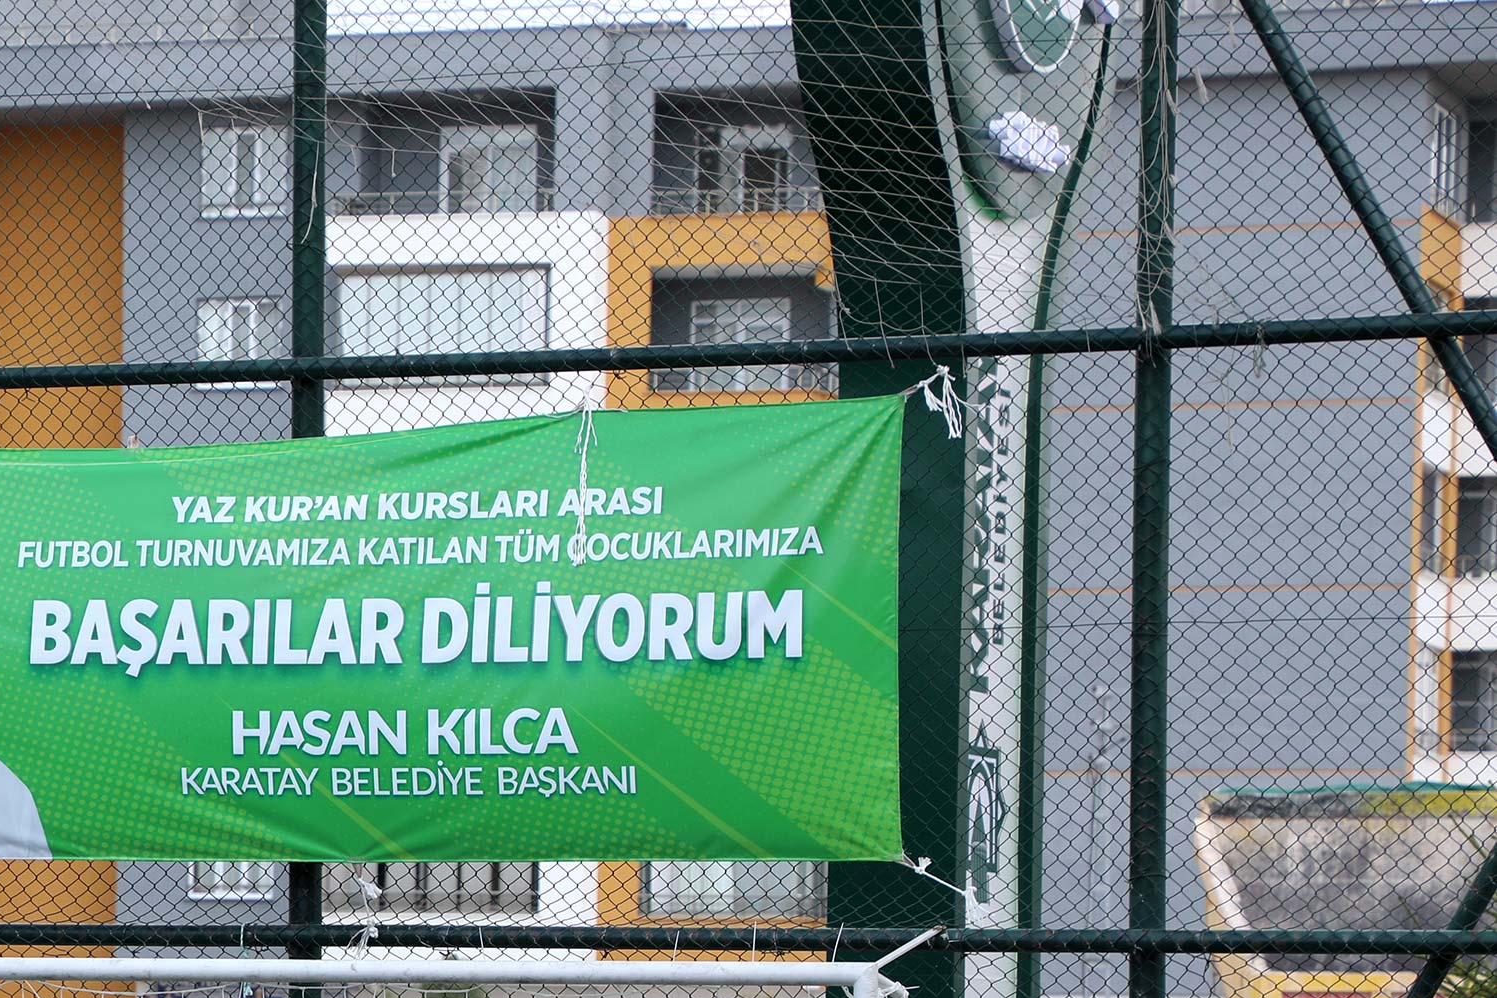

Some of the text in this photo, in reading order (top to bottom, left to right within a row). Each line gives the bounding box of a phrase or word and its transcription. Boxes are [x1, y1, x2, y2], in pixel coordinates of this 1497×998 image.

[171, 495, 236, 523] YAZ
[377, 489, 549, 521] KURSLARI
[557, 486, 663, 516] ARASI
[17, 540, 129, 567] FUTBOL
[136, 537, 351, 567] TURNUVAMIZA
[357, 535, 488, 565] KATILAN
[495, 529, 560, 563] TÜM
[29, 581, 803, 678] BAŞARILAR DİLİYORUM
[232, 707, 579, 755] HASAN KILCA
[181, 760, 637, 798] KARATAY BELEDİYE BAŞKANI
